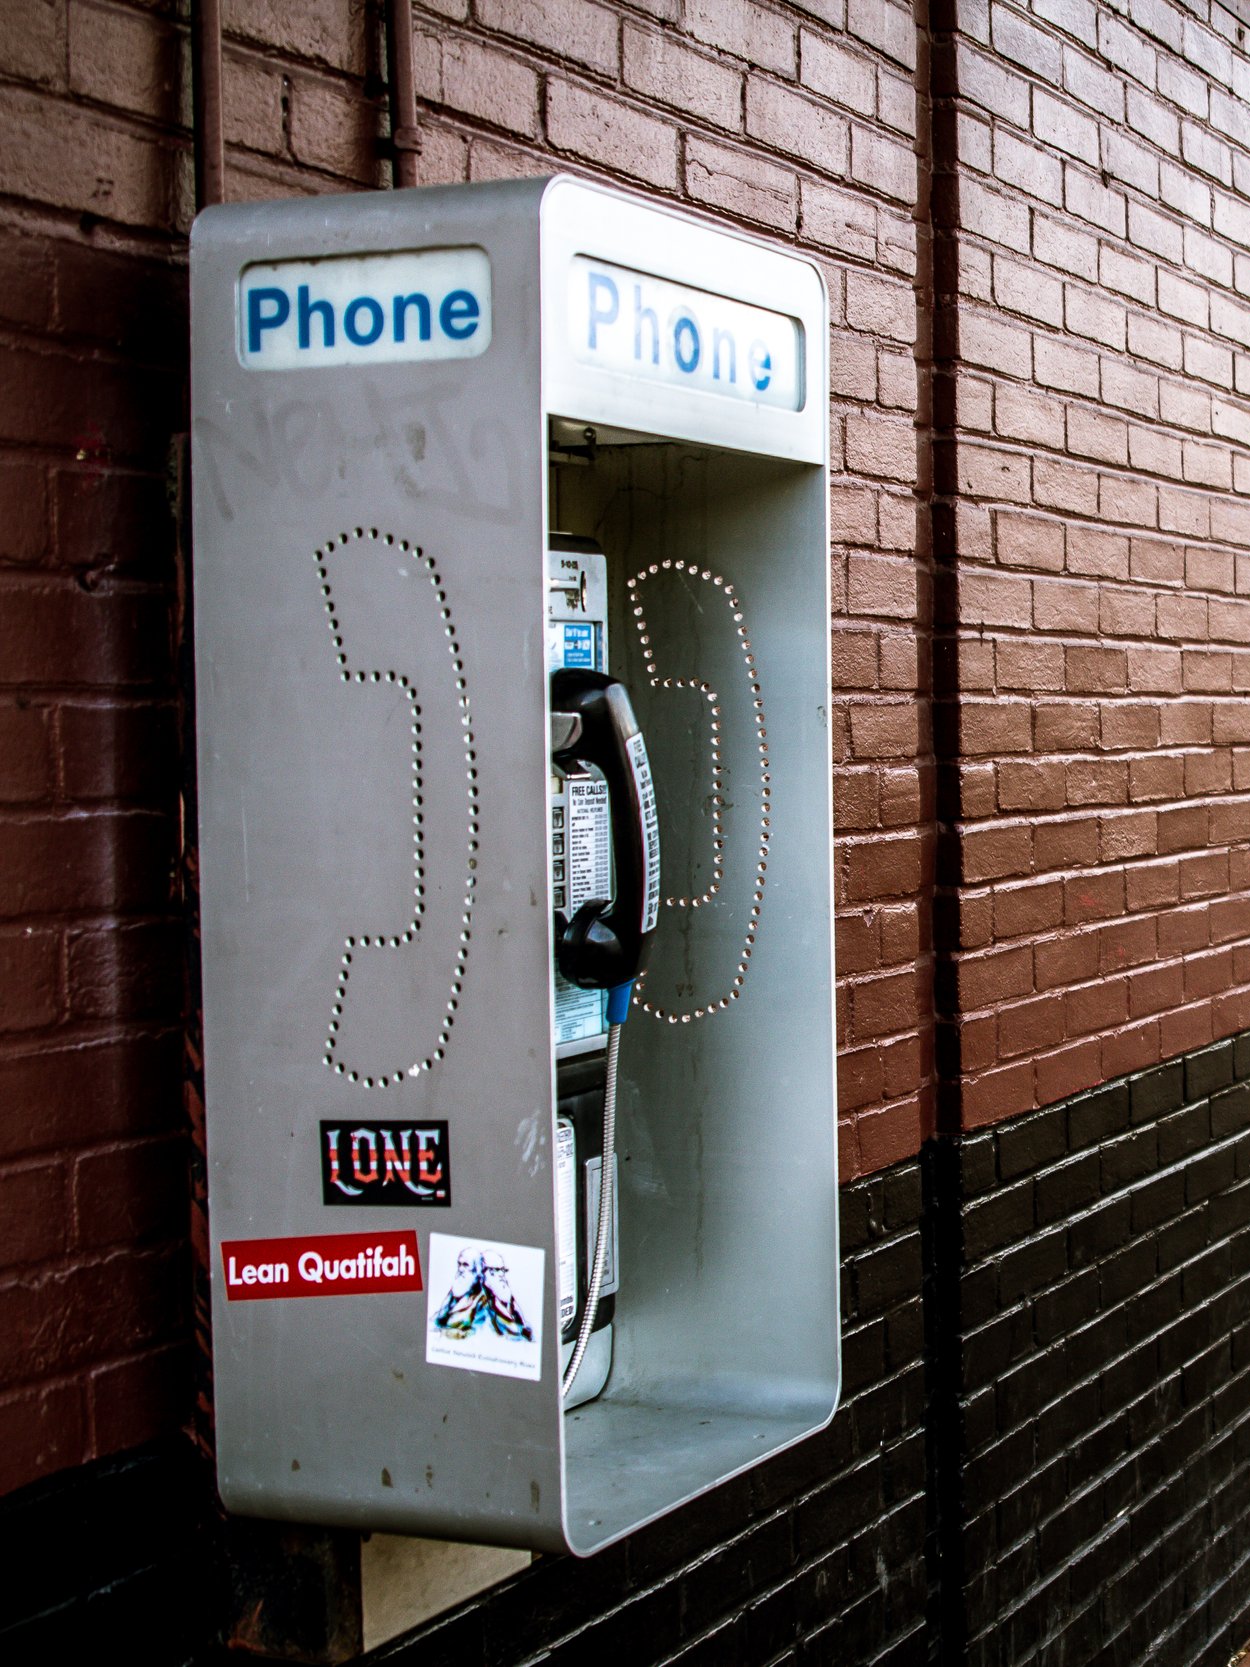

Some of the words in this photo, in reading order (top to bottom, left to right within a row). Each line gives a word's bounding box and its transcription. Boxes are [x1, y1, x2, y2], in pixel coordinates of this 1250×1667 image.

[247, 284, 480, 353] Phone
[587, 271, 772, 392] Phone
[571, 786, 586, 796] FREE
[326, 1128, 443, 1195] LONE
[228, 1257, 290, 1286] Lean
[298, 1244, 416, 1284] Quatifah
